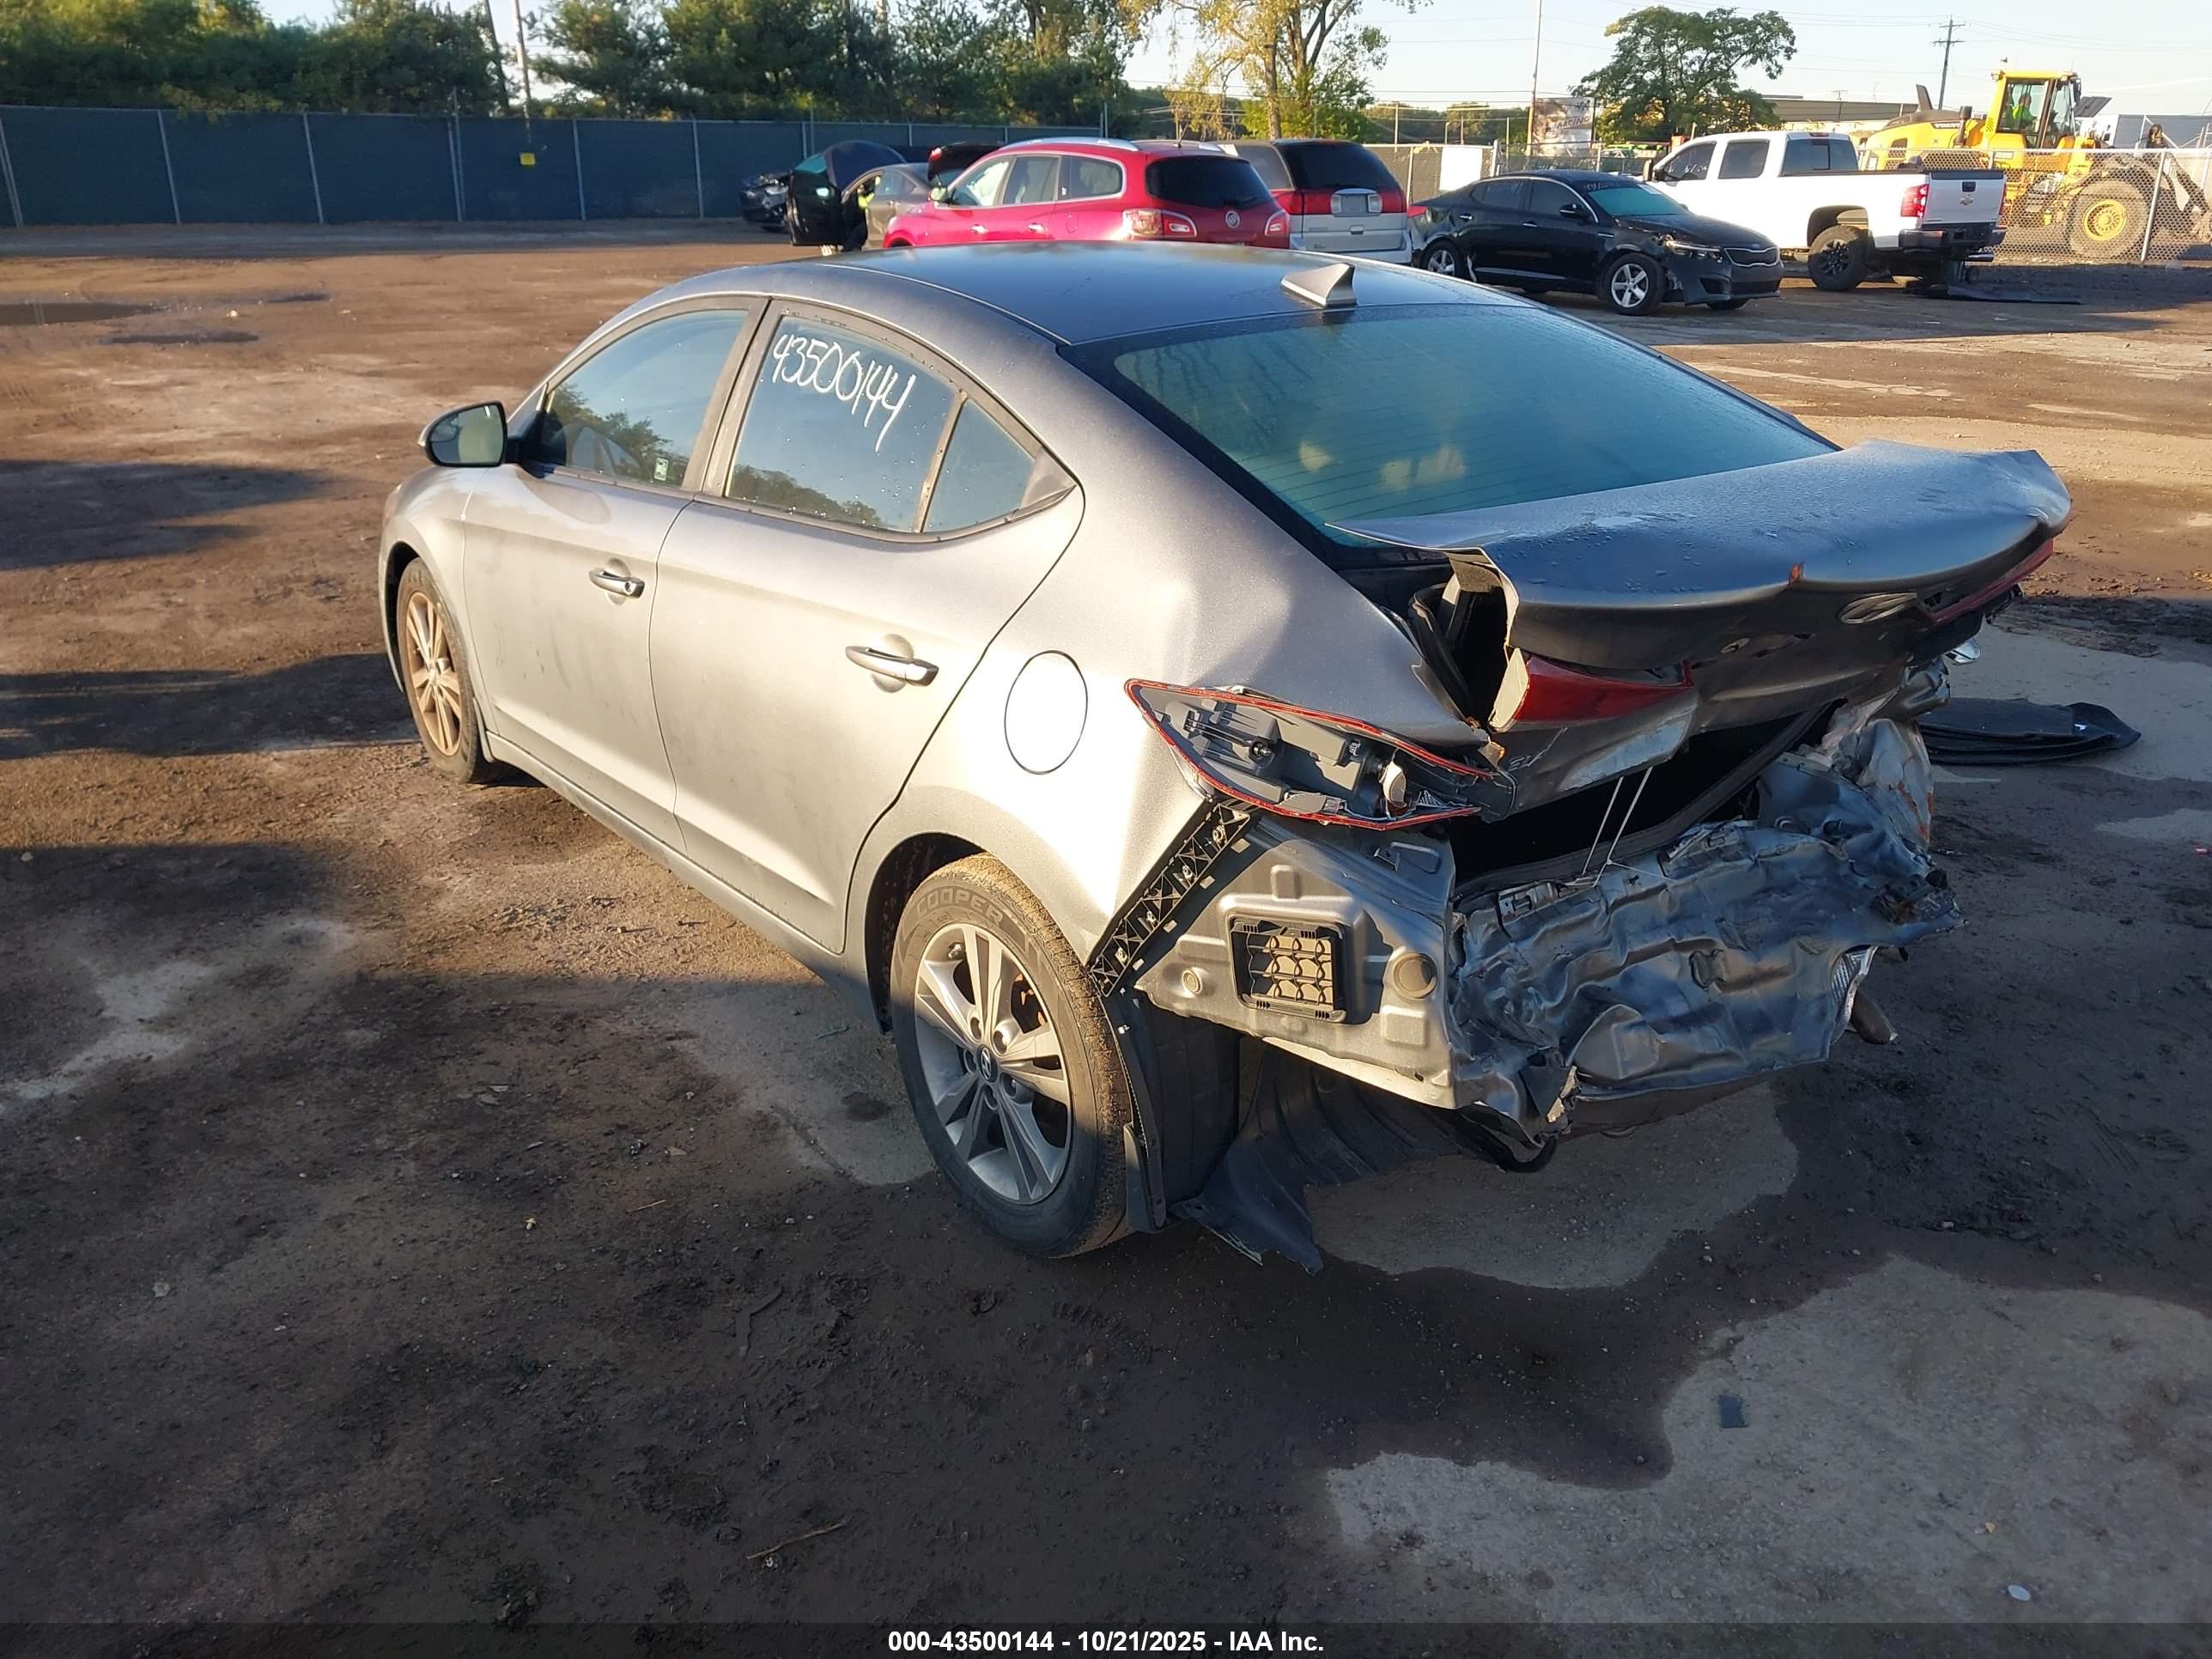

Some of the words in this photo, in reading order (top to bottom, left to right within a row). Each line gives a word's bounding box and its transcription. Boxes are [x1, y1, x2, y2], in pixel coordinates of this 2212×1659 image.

[1557, 116, 1590, 128] RACING
[773, 333, 917, 453] 43500144
[916, 888, 1003, 926] COOPER
